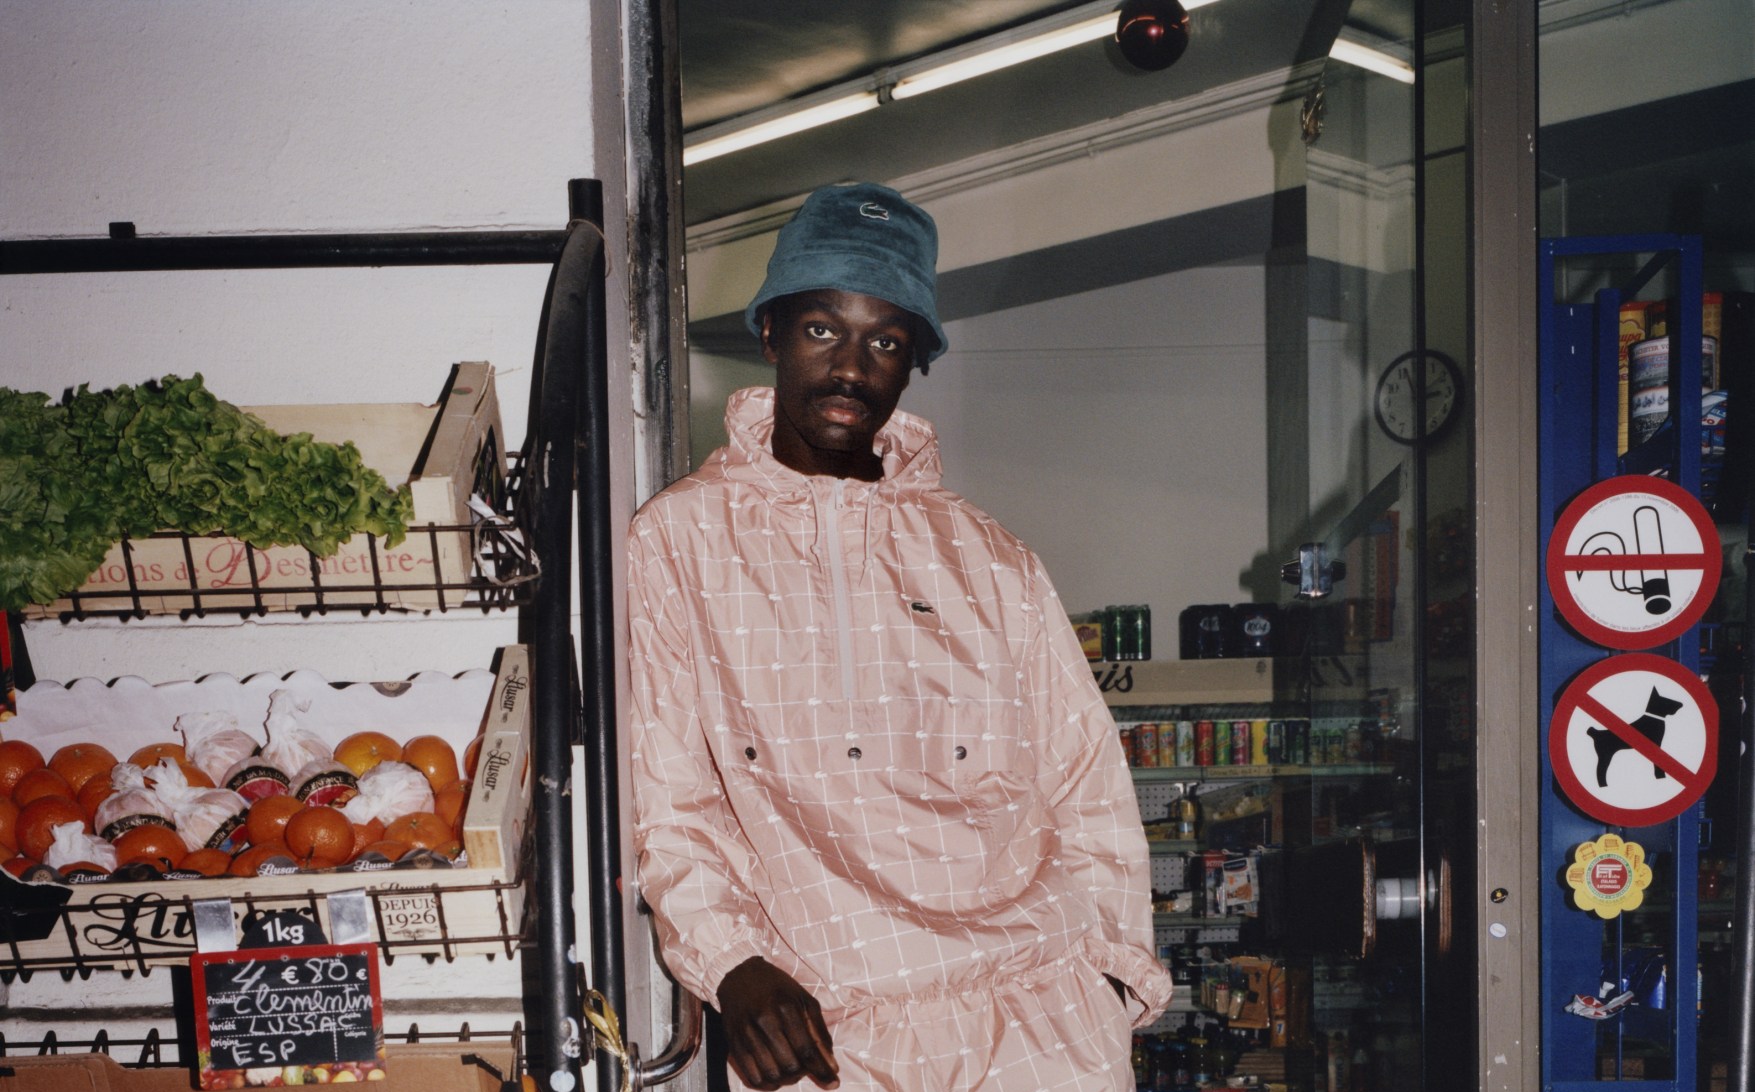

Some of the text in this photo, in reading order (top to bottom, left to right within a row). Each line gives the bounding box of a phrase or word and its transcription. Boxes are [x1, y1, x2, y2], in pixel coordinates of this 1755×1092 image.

[257, 863, 298, 877] Llusar
[353, 860, 395, 872] Llusar
[69, 873, 110, 884] Llusar
[379, 898, 438, 912] DEPUIS
[385, 909, 436, 929] 1926
[262, 917, 304, 944] 1kg
[231, 958, 368, 993] 4 € 80 €
[207, 996, 238, 1006] Produit
[209, 1020, 236, 1032] Variété
[211, 1038, 296, 1066] Origine ESP
